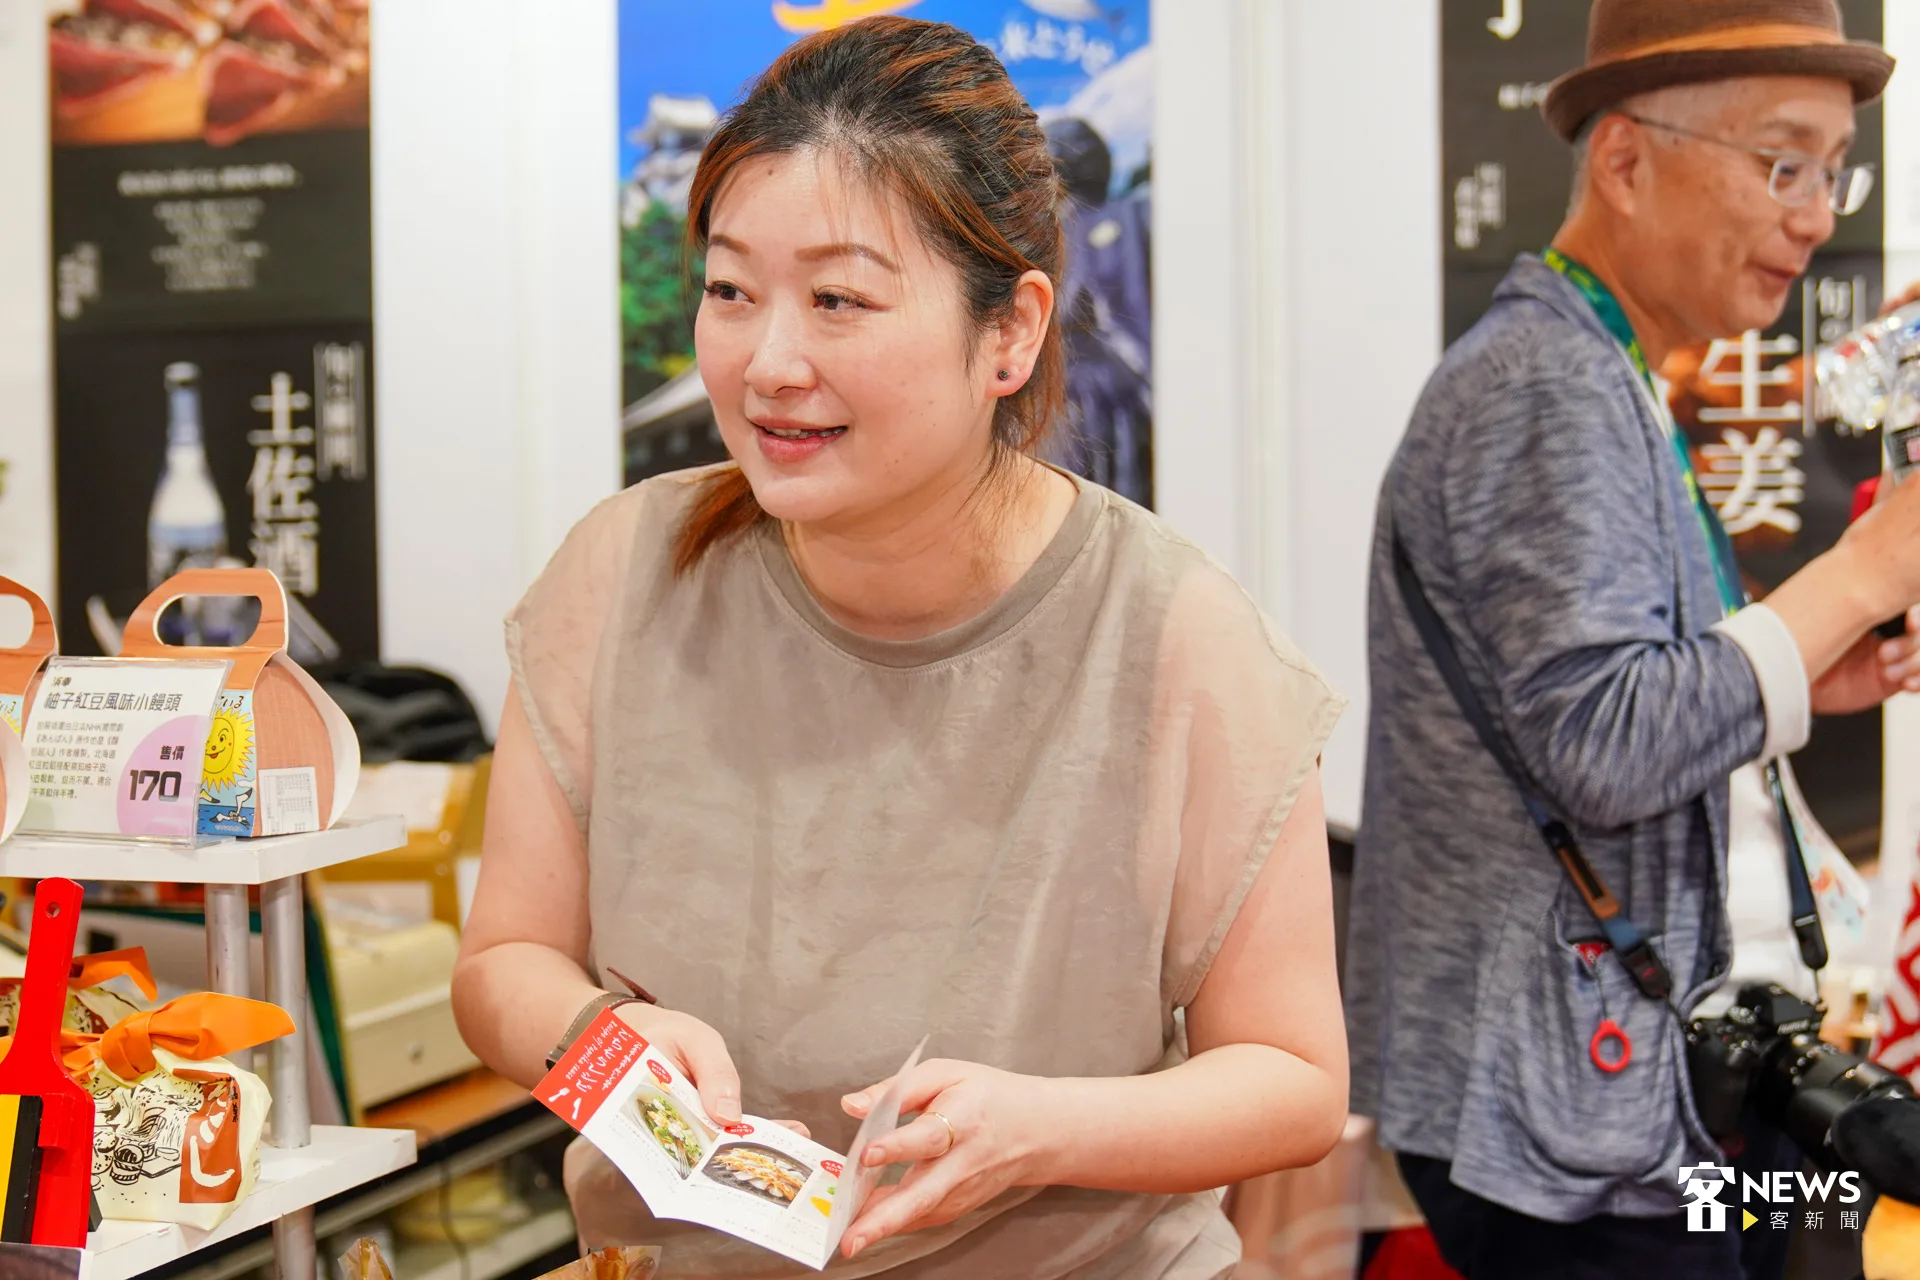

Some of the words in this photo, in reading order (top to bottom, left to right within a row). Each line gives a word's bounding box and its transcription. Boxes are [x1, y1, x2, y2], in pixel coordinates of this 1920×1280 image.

[1697, 328, 1807, 535] 生姜
[246, 371, 319, 598] 土佐酒
[43, 691, 183, 712] 柚子紅豆風味小饅頭
[159, 745, 185, 760] 售價
[129, 769, 182, 802] 170
[575, 1027, 634, 1093] ごちそうレシピ
